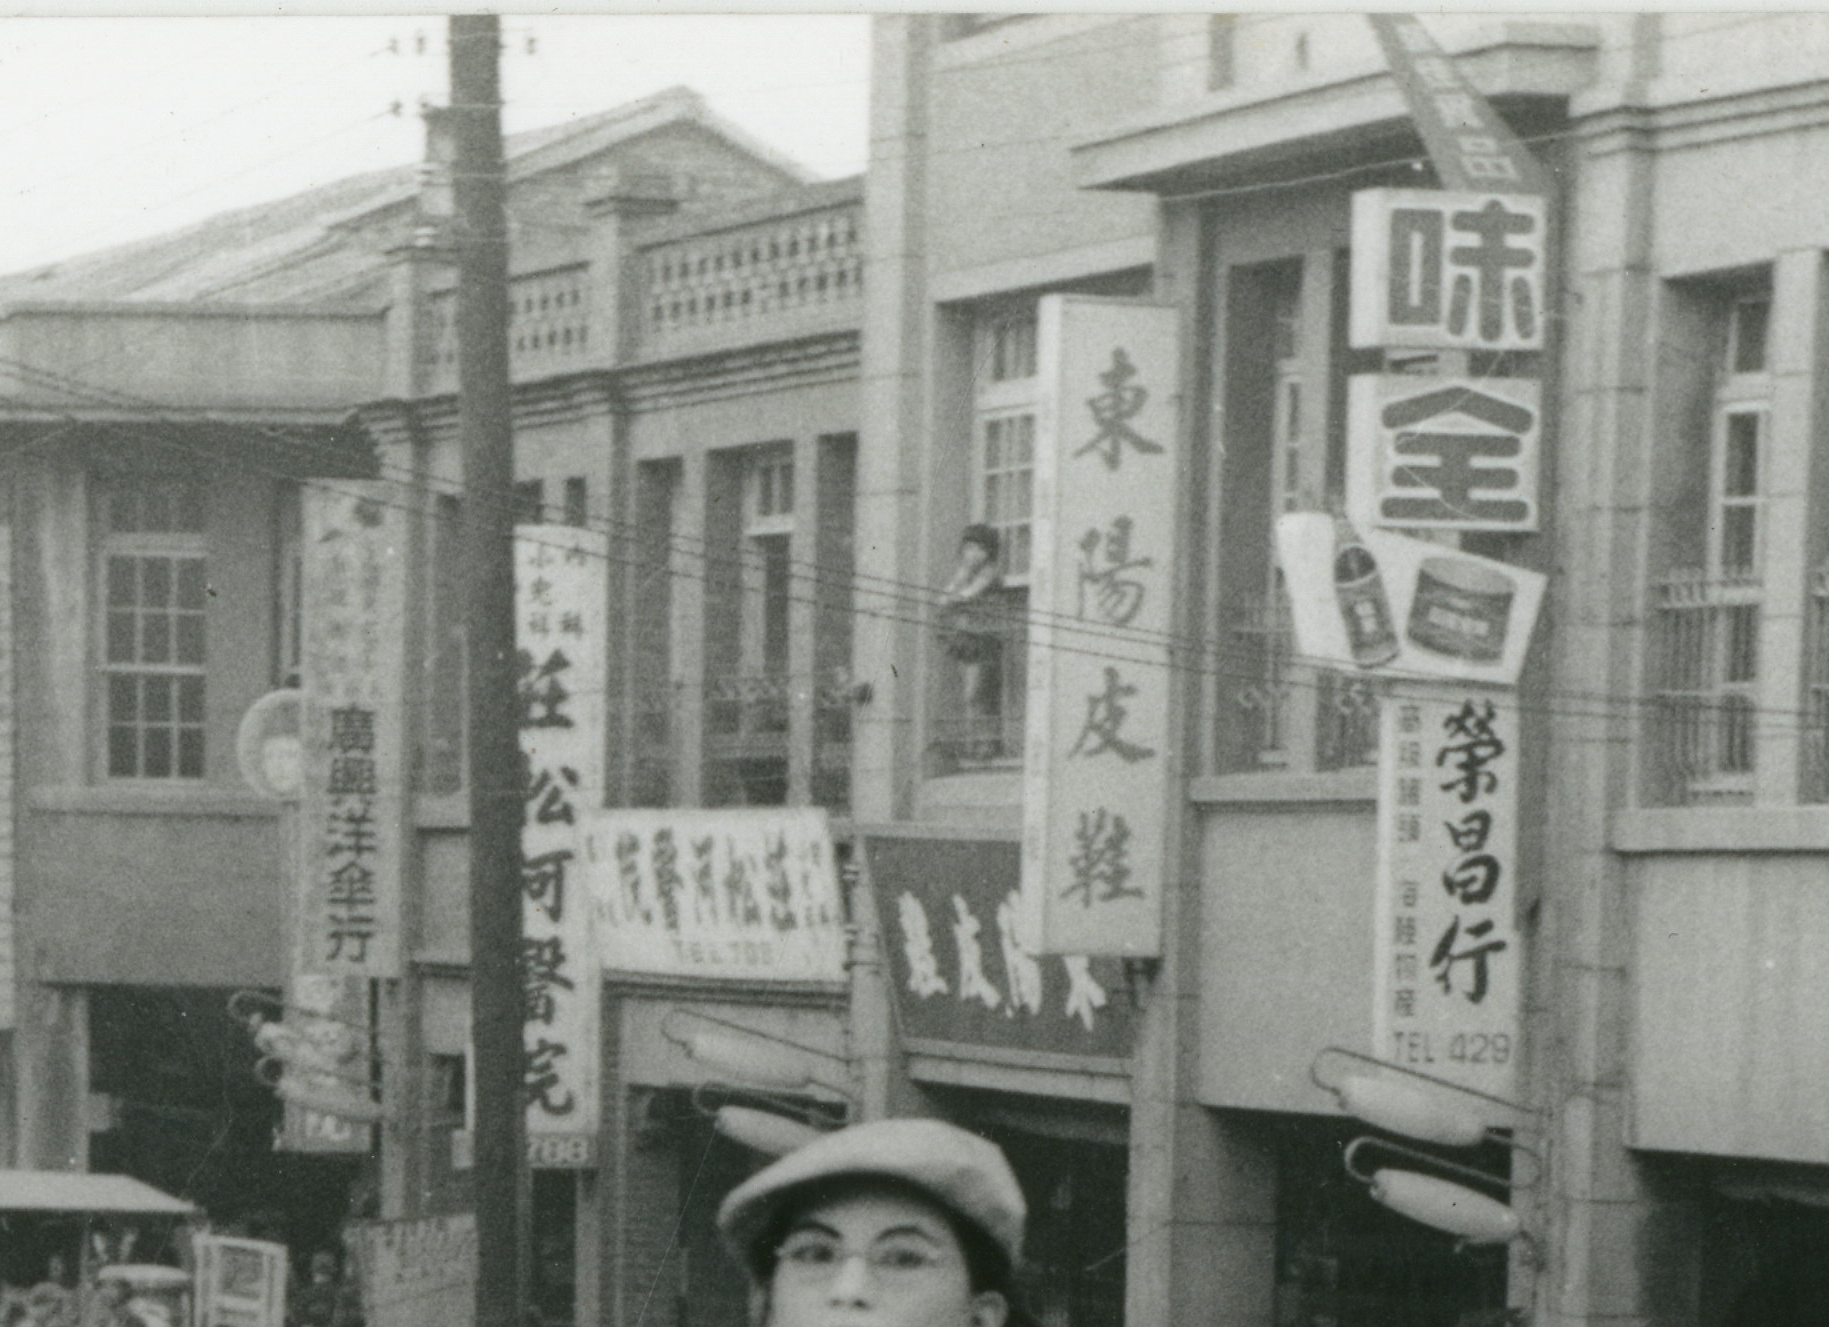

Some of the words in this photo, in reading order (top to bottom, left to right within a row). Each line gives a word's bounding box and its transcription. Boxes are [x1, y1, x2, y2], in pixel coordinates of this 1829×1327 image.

[1056, 347, 1164, 910] 東陽皮鞋
[1429, 699, 1508, 1004] 榮昌行
[1392, 1032, 1435, 1066] TEL
[1449, 1033, 1511, 1066] 429
